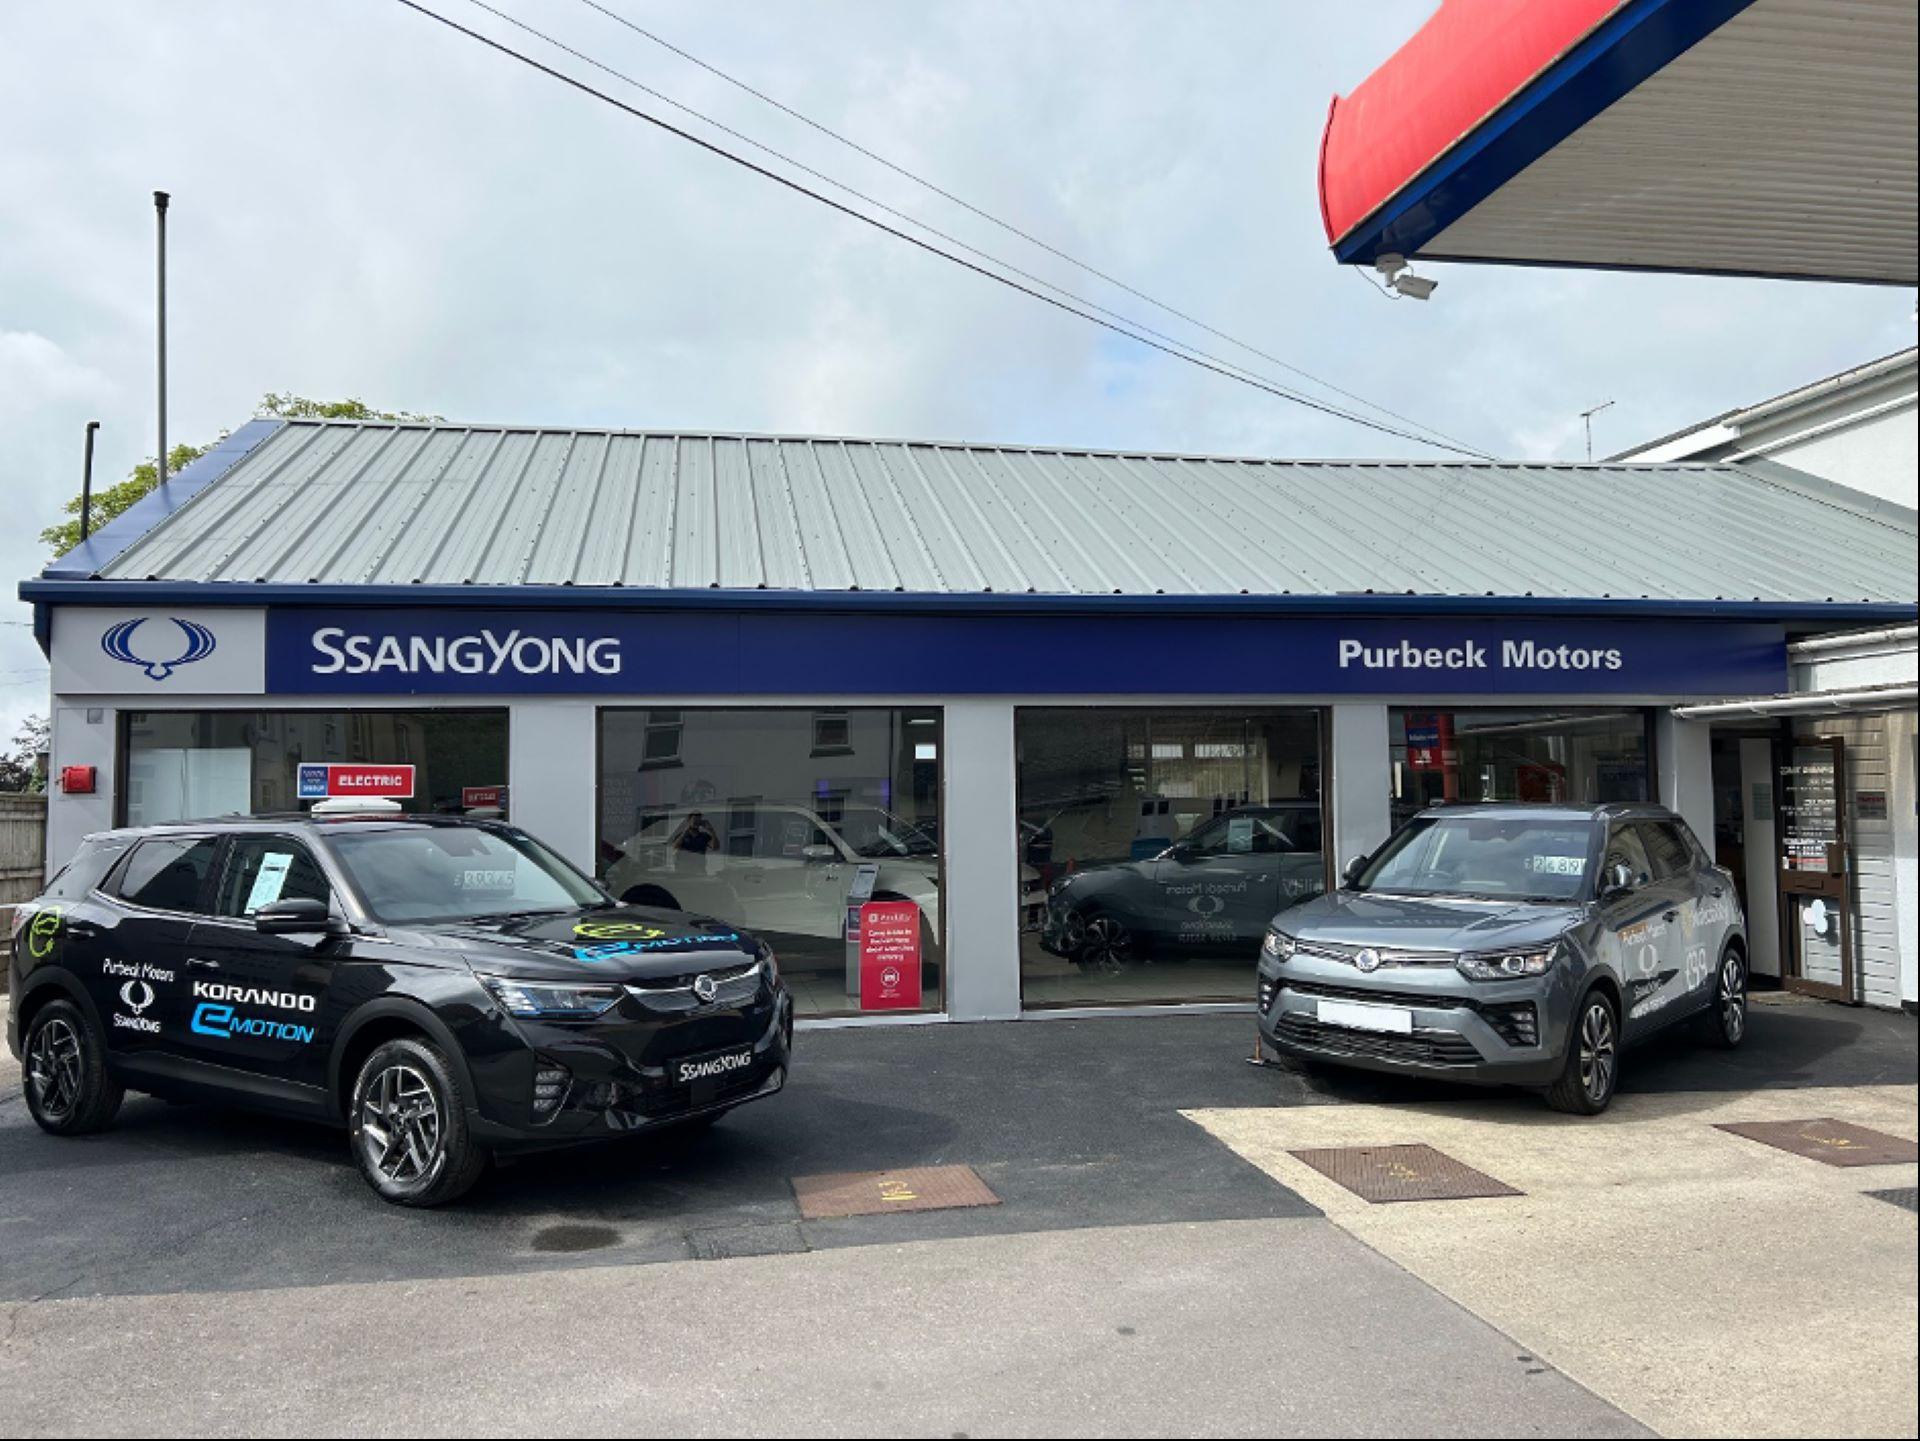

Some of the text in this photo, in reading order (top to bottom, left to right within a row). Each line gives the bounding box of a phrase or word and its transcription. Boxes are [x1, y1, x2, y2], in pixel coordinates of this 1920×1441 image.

[1338, 639, 1623, 670] Purbeck Motors
[338, 774, 402, 787] ELECTRIC
[103, 958, 175, 982] Purbeck Motors
[192, 981, 316, 1012] KORANDO
